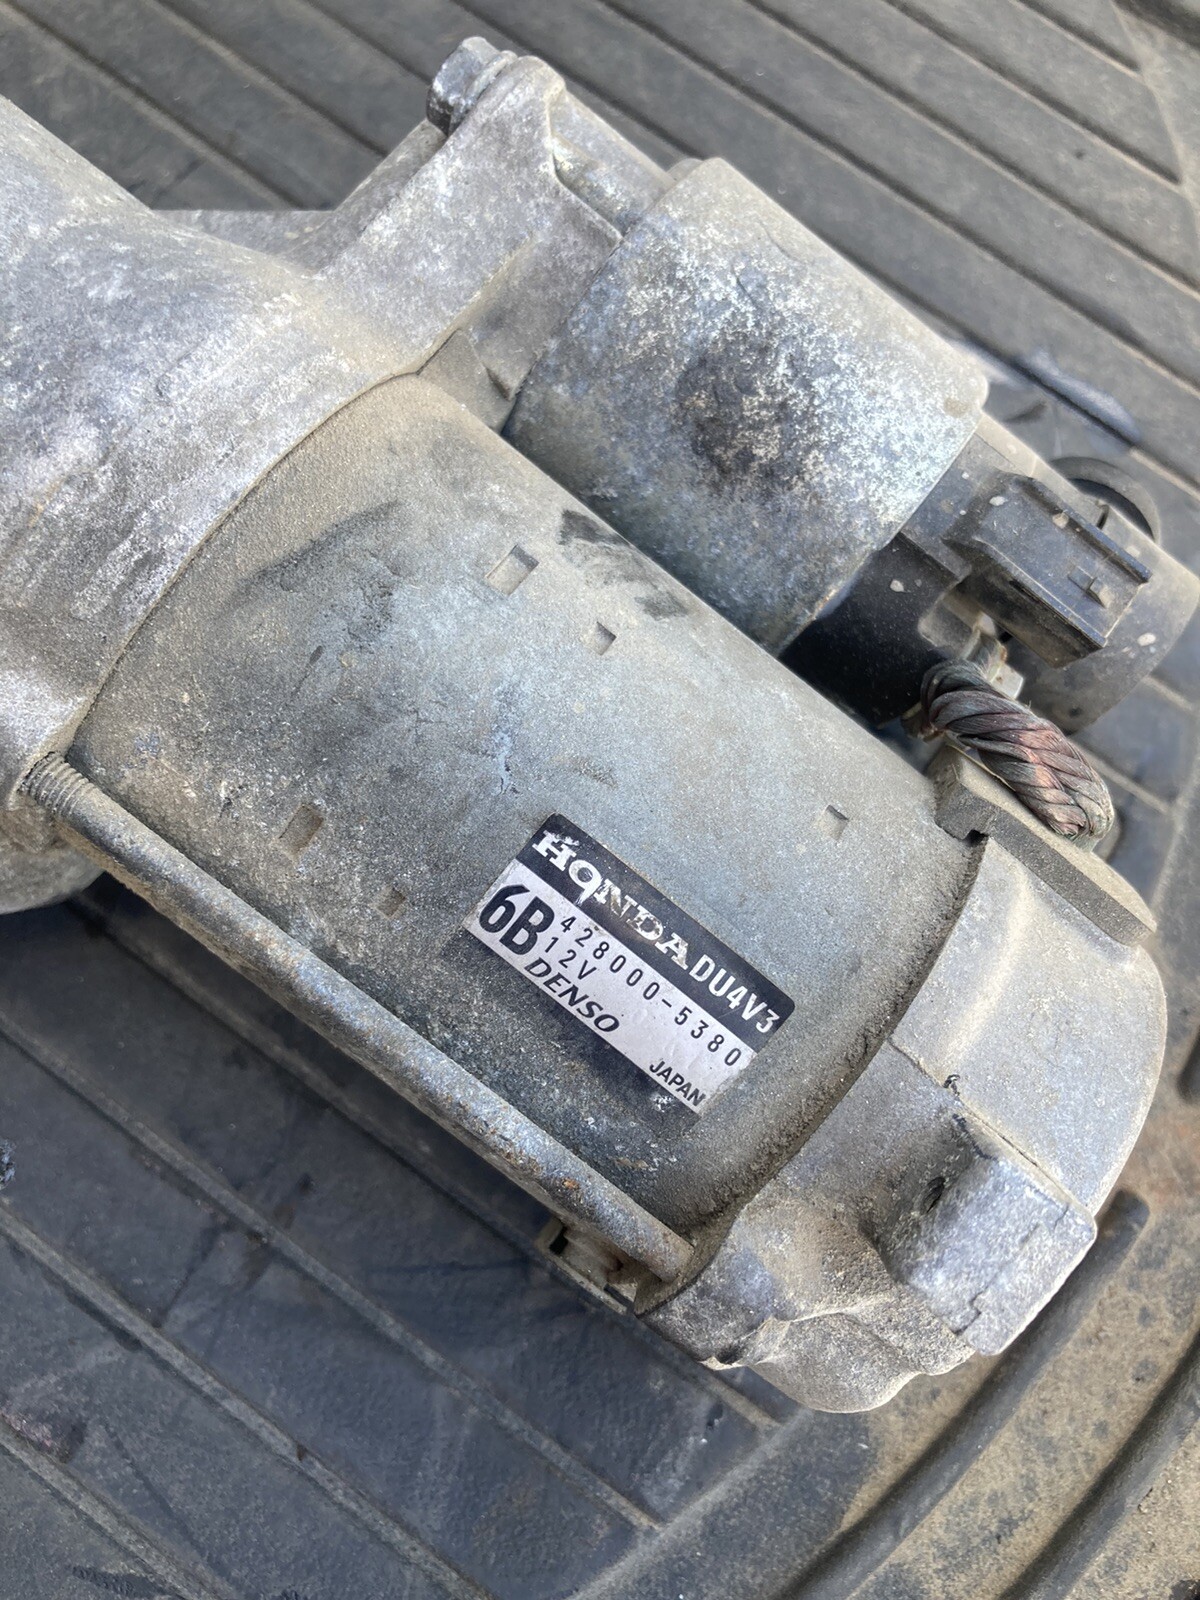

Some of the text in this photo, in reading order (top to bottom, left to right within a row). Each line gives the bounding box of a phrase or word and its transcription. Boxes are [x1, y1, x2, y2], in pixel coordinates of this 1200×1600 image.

[478, 884, 555, 955] 6B
[532, 830, 780, 1034] HONDA DU4V3
[524, 957, 620, 1033] DENSO
[545, 937, 597, 981] 12V
[560, 916, 742, 1067] 428000-5380
[649, 1060, 706, 1107] JAPAN
